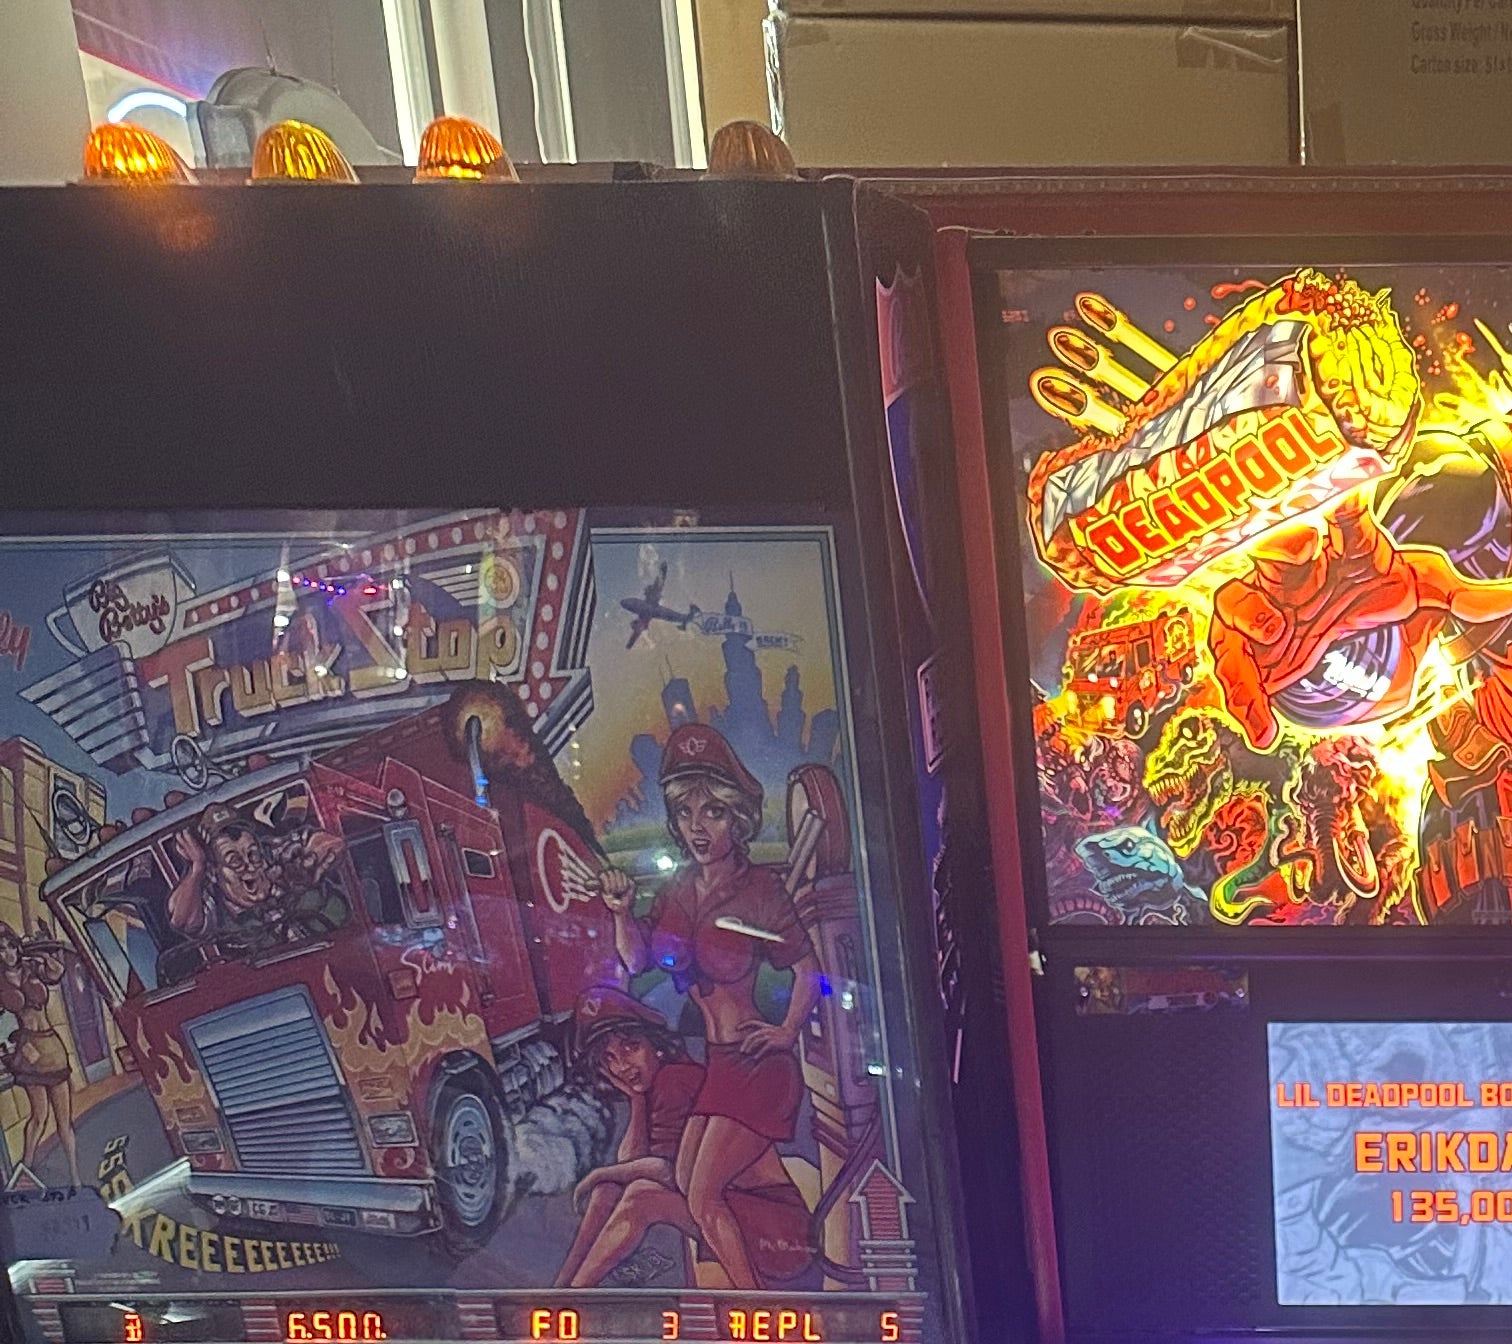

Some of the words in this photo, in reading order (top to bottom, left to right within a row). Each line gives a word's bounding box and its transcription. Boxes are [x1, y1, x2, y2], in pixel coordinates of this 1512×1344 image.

[1085, 408, 1345, 576] DEADPOOL
[145, 610, 346, 737] Truck
[325, 592, 527, 698] Stop
[1276, 1084, 1320, 1108] LIL
[1326, 1083, 1475, 1108] DEADPOOL
[662, 1311, 680, 1341] 3
